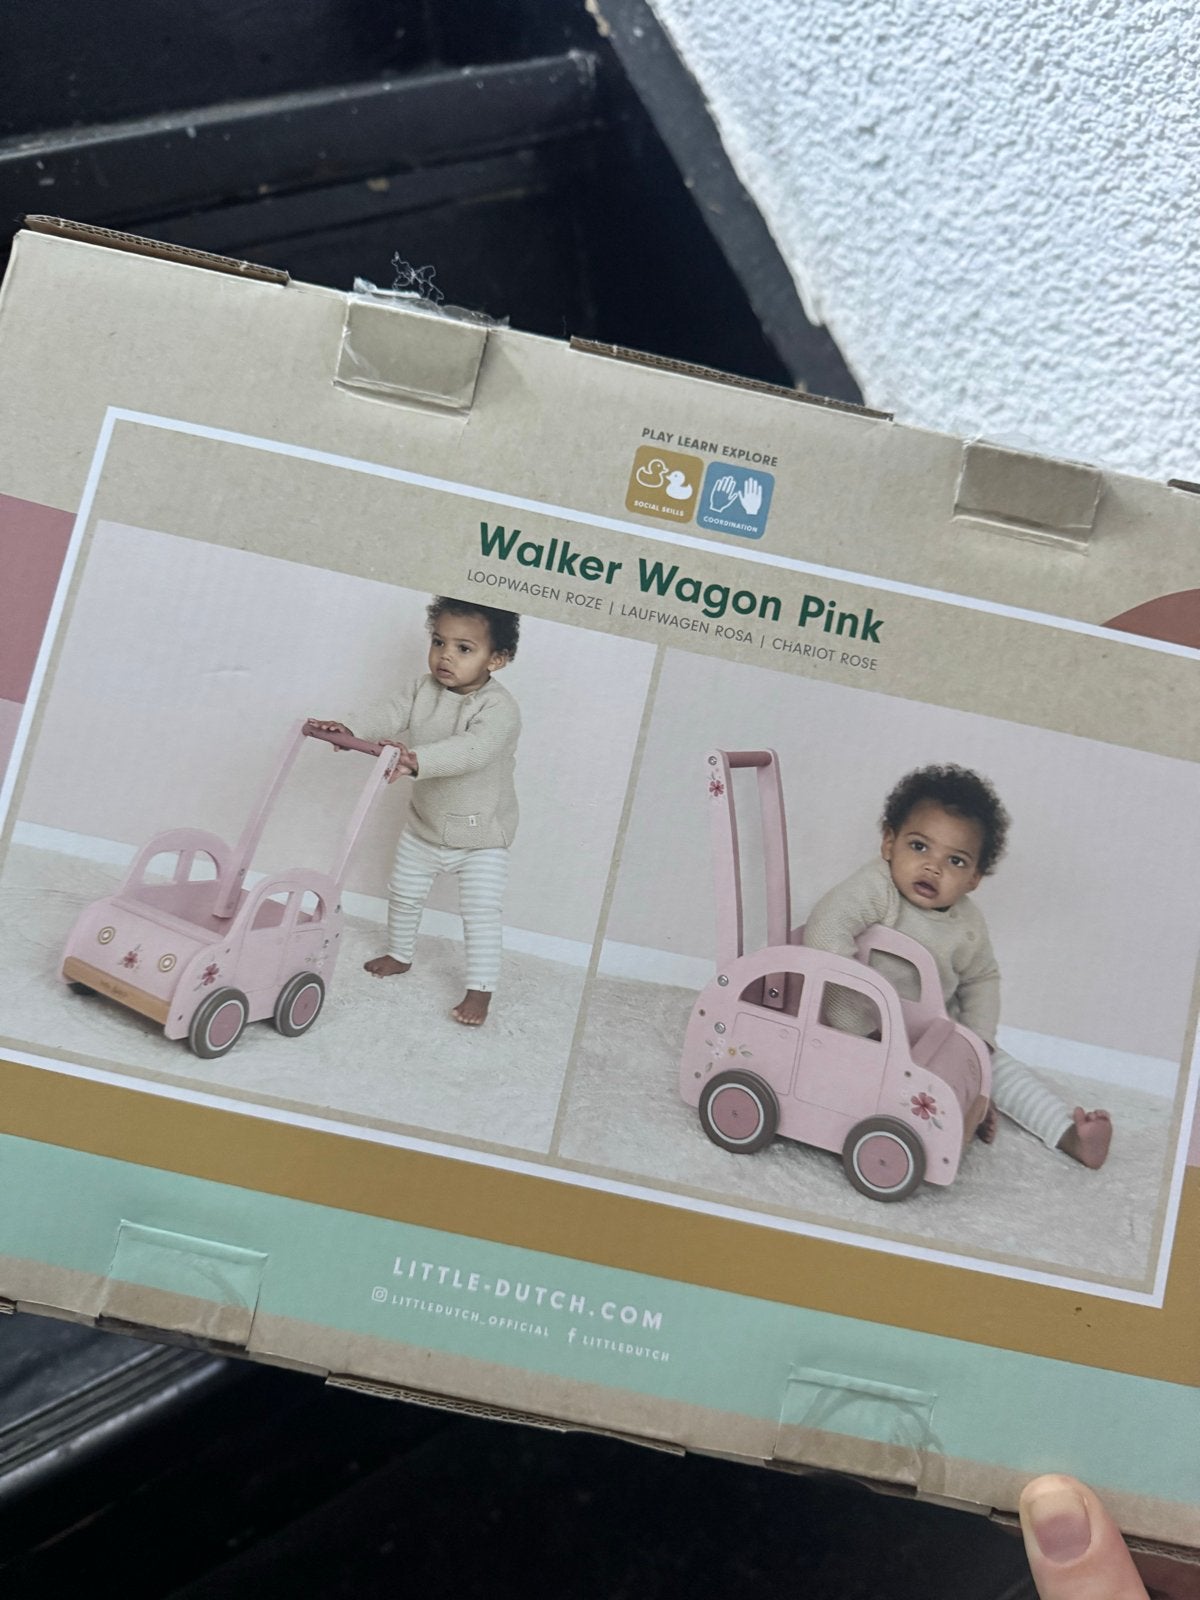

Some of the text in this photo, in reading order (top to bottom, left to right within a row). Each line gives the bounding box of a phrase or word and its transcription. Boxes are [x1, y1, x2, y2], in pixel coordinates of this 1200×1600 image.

[642, 427, 778, 467] PLAY LEARN EXPLORE
[634, 500, 684, 517] SOCIAL SKILLS
[703, 516, 758, 532] COORDINATION
[480, 522, 886, 644] Walker Wagon Pink
[467, 569, 561, 601] LOOPWAGEN
[566, 591, 603, 610] ROZE
[621, 604, 710, 633] LAUFWAGEN
[715, 625, 754, 643] ROSA
[772, 637, 836, 662] CHARIOT
[840, 652, 878, 671] ROSE
[393, 1256, 664, 1330] LITTLE-DUTCH.COM
[392, 1295, 551, 1337] LITTLEDUTCH_OFFICIAL
[582, 1335, 670, 1362] LITTLEDUTCH
